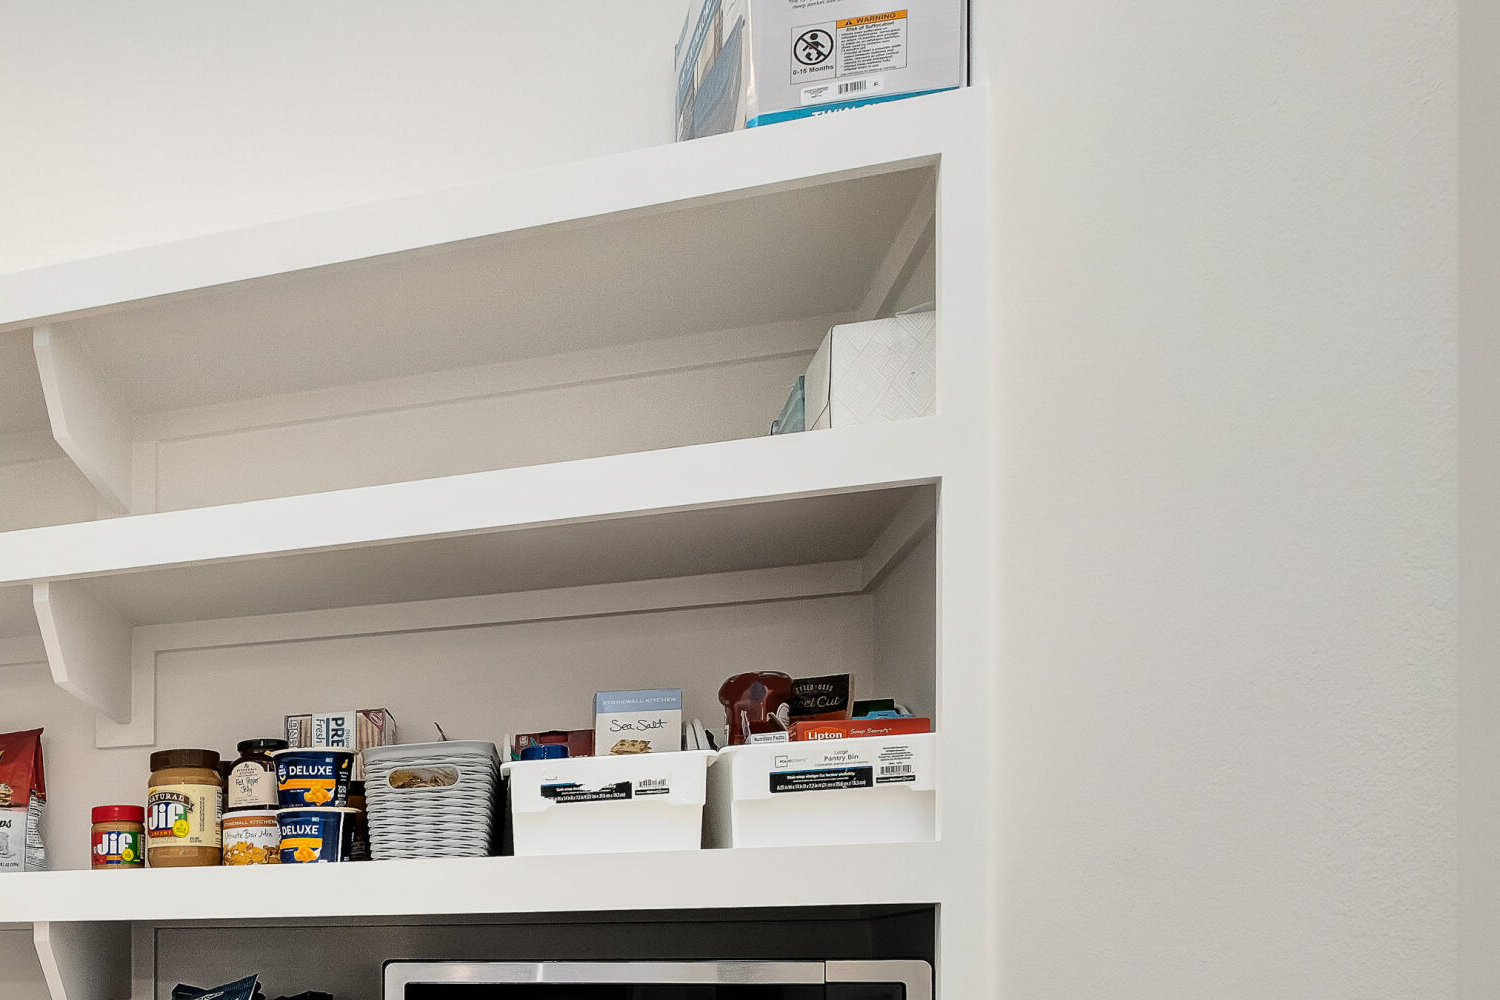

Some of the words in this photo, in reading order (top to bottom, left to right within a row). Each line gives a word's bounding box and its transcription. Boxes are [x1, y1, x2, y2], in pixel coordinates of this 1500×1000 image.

[856, 12, 896, 24] WARNING
[809, 64, 834, 73] Months
[817, 696, 841, 707] Cut
[316, 718, 326, 744] Fresh
[610, 720, 635, 732] Sea
[638, 718, 668, 732] Salt
[808, 732, 844, 740] Lipton
[289, 766, 333, 776] DELUXE
[148, 803, 185, 831] Jif
[282, 824, 319, 836] DELUXE
[97, 833, 133, 855] Jif
